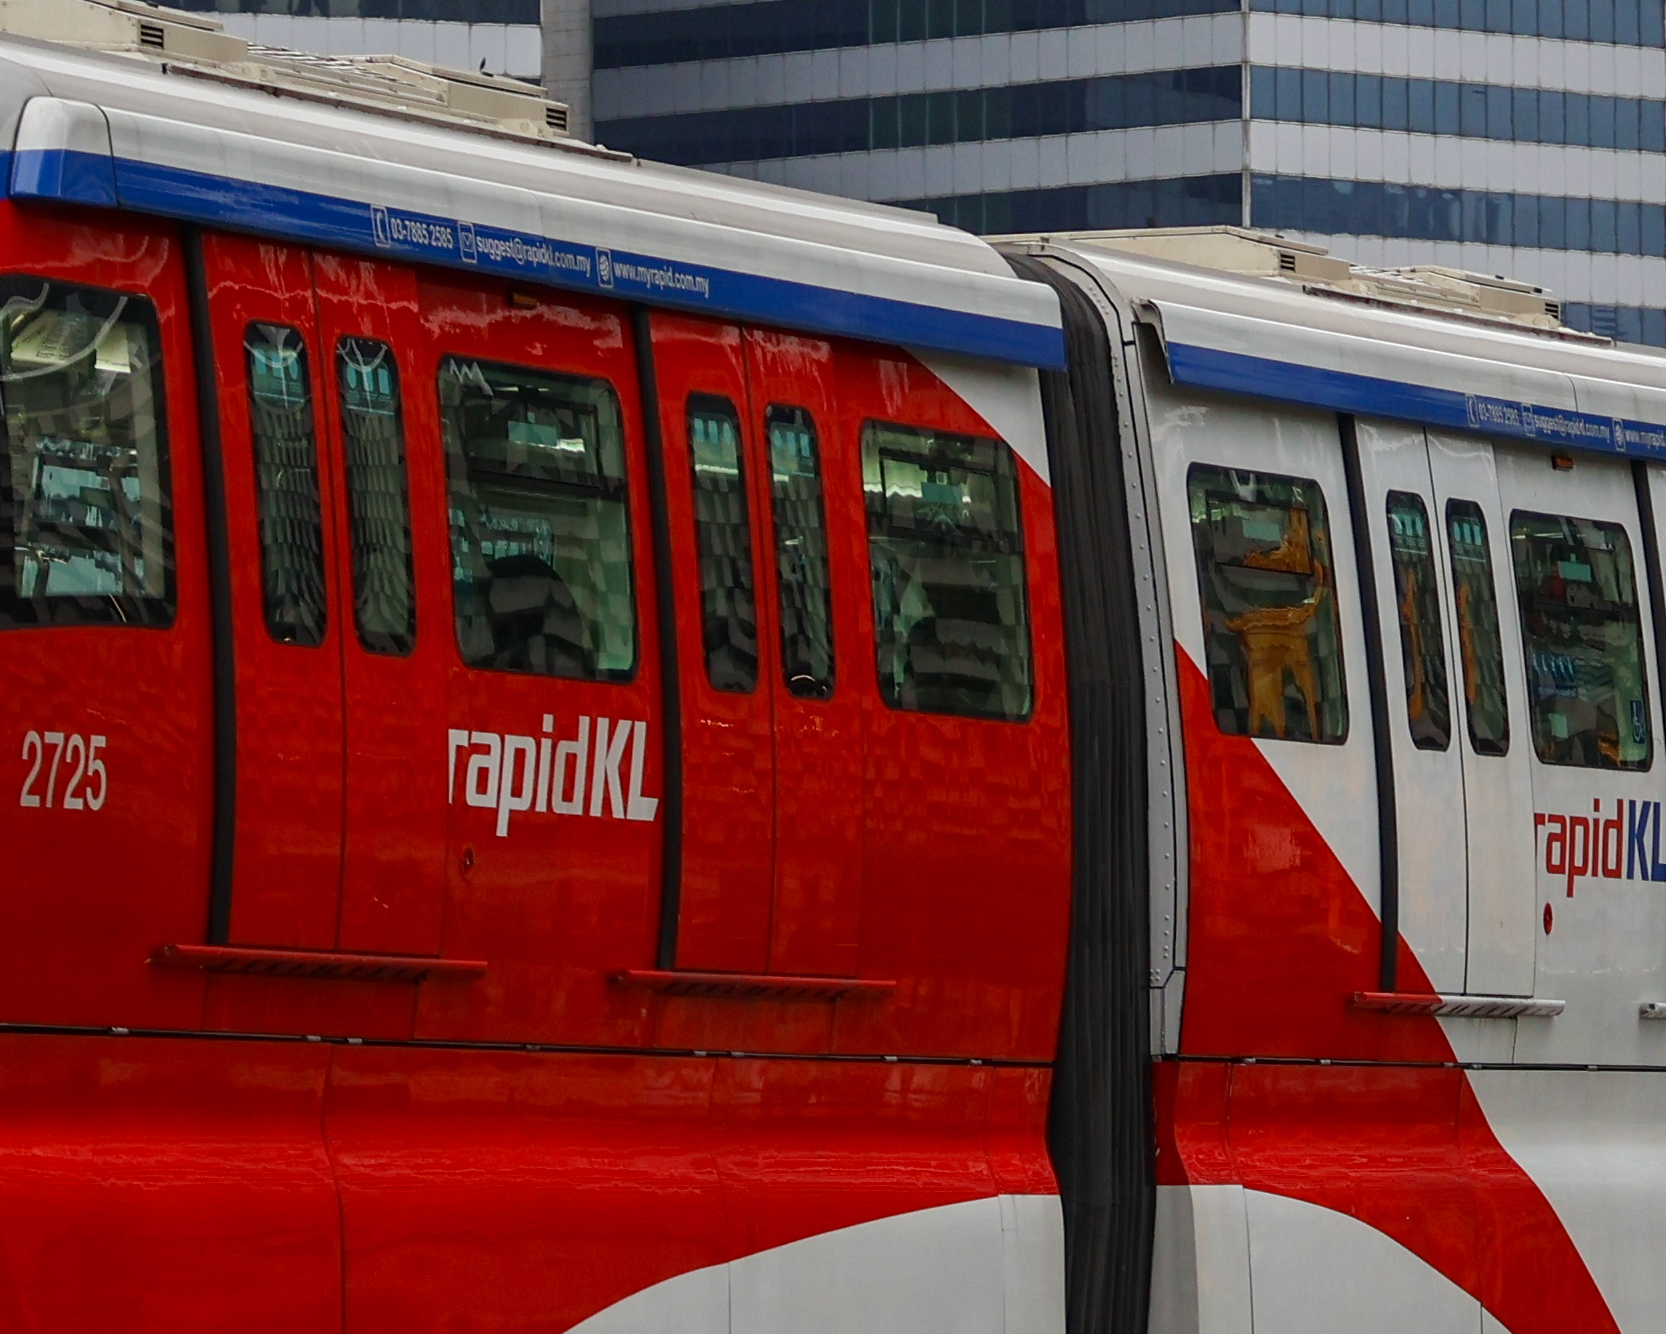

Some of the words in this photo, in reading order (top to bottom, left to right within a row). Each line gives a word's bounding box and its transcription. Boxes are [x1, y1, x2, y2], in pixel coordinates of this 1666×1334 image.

[390, 217, 429, 245] 03-7885
[430, 227, 453, 249] 2585
[475, 235, 591, 278] suggest@rapidkl.com.my
[612, 261, 709, 299] www.myrapid.com.my
[20, 730, 107, 811] 2725
[448, 714, 659, 838] rapidKL
